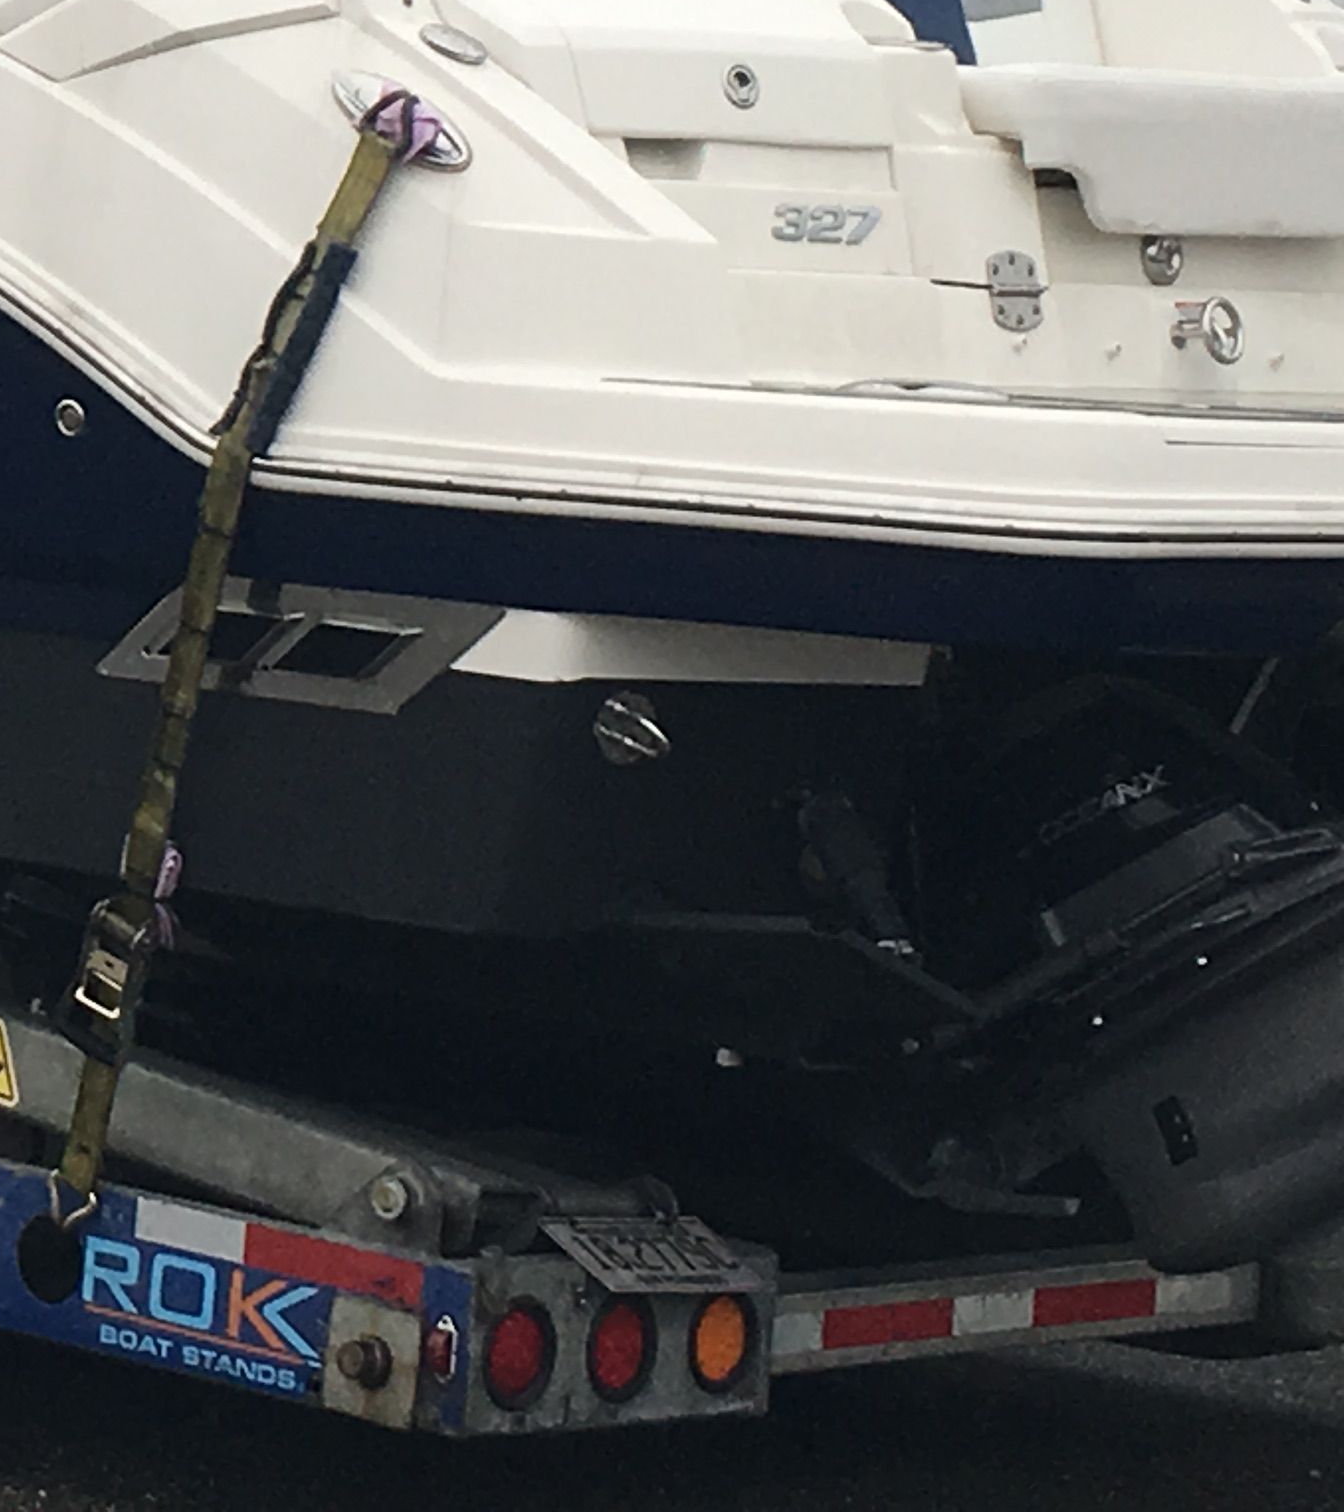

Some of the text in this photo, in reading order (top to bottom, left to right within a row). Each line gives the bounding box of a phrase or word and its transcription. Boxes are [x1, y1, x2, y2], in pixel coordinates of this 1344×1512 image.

[771, 203, 882, 245] 327
[99, 1323, 297, 1391] BOAT STANDS
